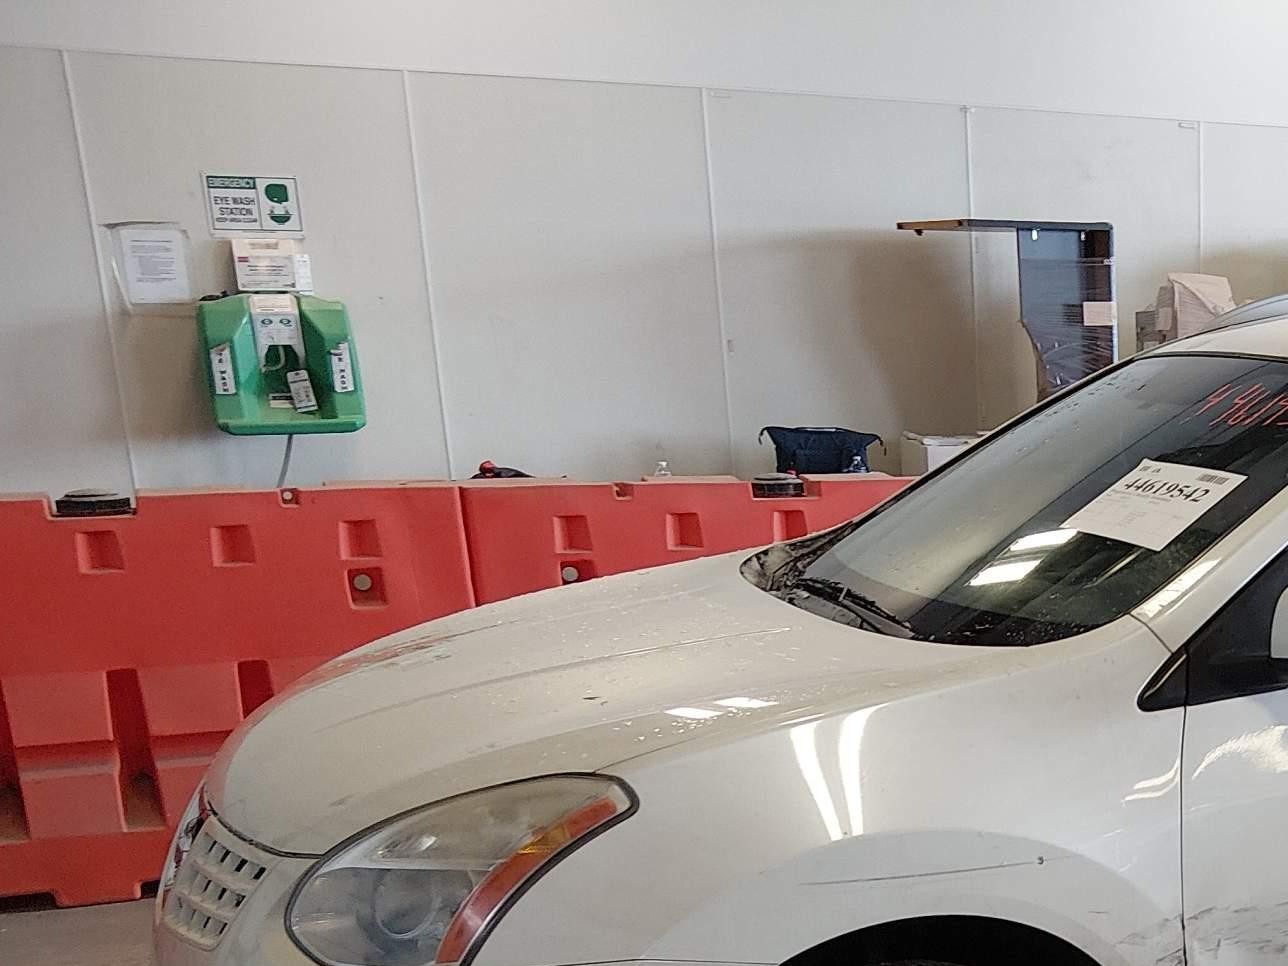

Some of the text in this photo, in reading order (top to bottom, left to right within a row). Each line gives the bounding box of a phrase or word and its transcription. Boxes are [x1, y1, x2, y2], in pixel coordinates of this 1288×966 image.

[208, 177, 255, 188] EMERGENCY
[213, 196, 256, 206] EYE WASH
[218, 207, 254, 216] STATION
[1124, 477, 1211, 503] 44619542
